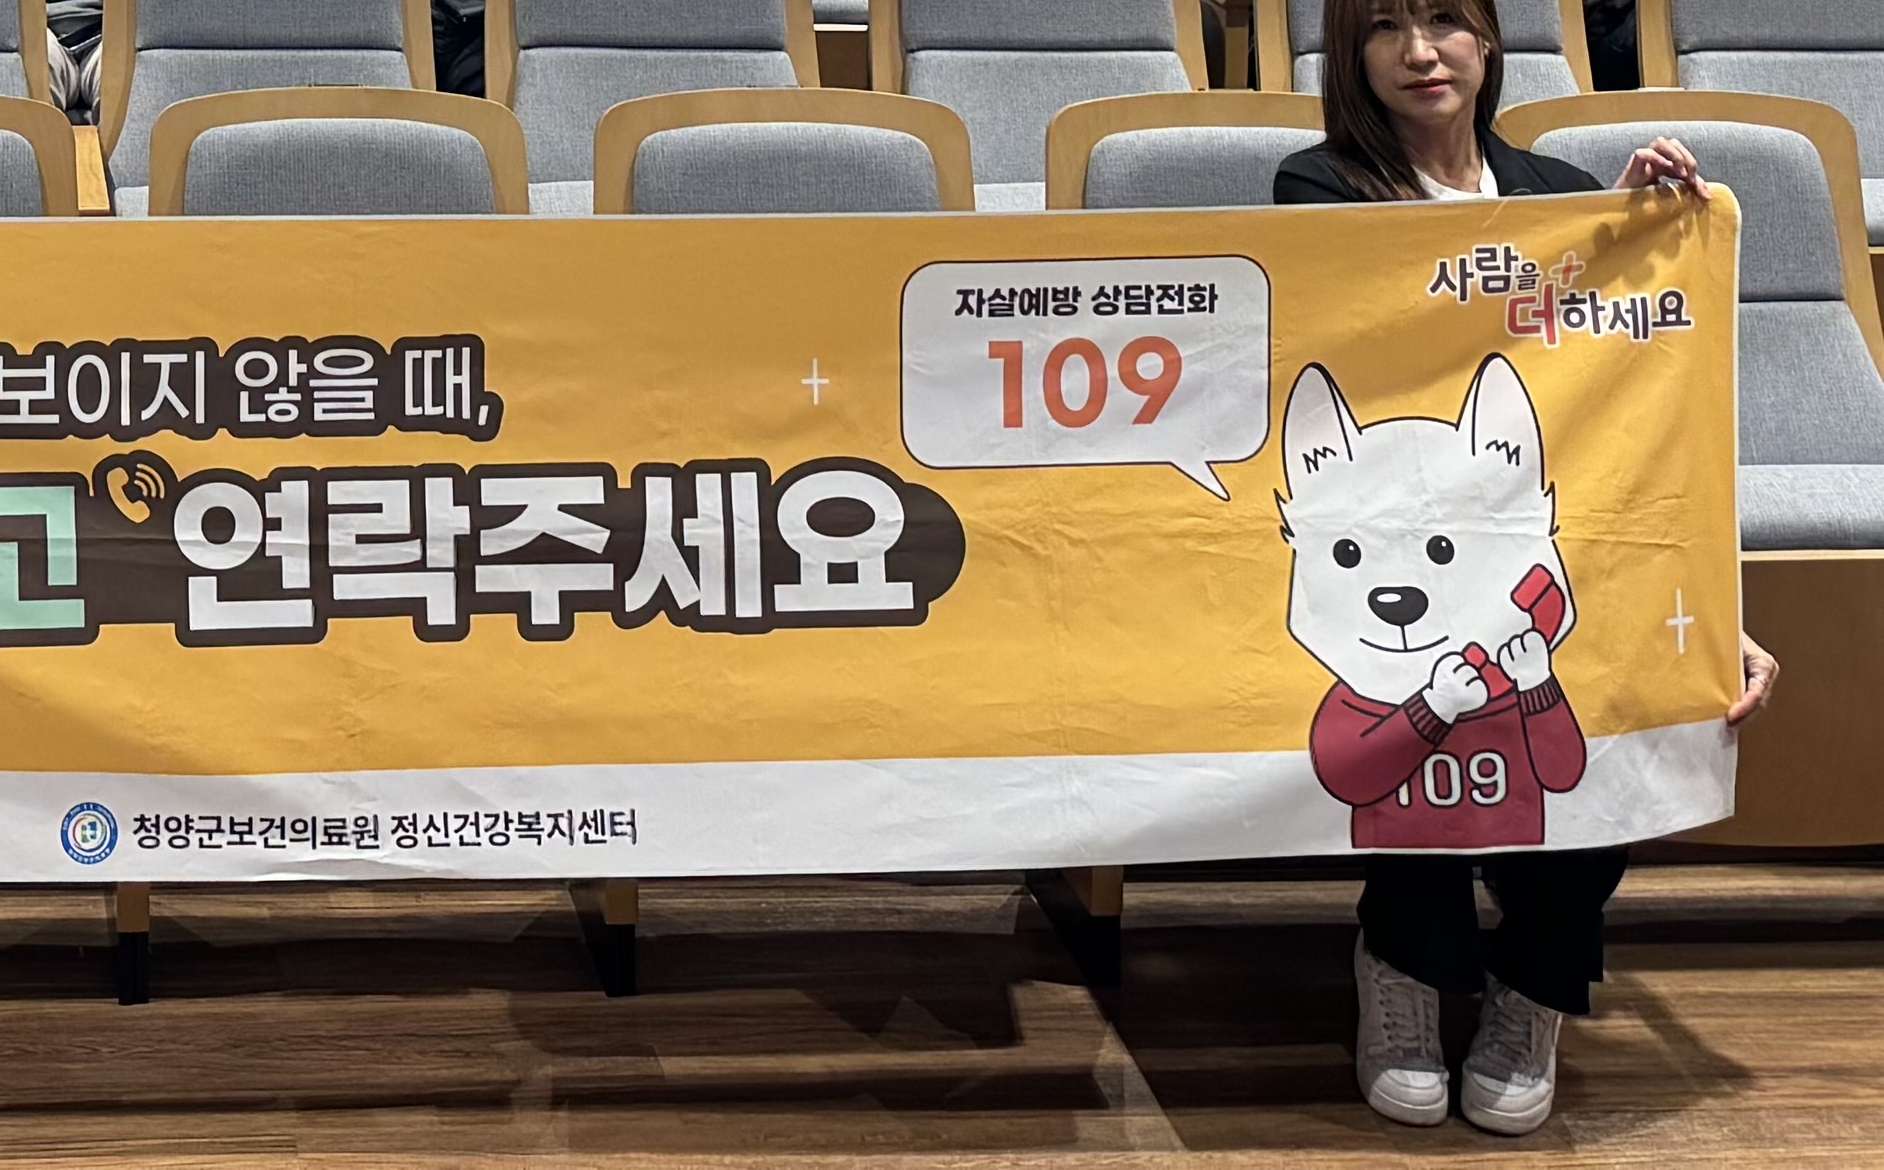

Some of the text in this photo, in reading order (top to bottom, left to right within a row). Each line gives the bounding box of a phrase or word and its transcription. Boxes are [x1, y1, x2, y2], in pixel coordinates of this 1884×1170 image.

[955, 283, 1219, 319] 자살예방 상담전화
[1429, 246, 1540, 302] 사람을
[1507, 283, 1692, 345] 더하세요
[234, 348, 379, 423] 않을
[404, 347, 489, 427] 때,
[988, 336, 1184, 430] 109
[173, 470, 914, 631] 연락주세요
[132, 814, 381, 851] 청양군보건의료원
[390, 809, 638, 850] 정신건강복지센터
